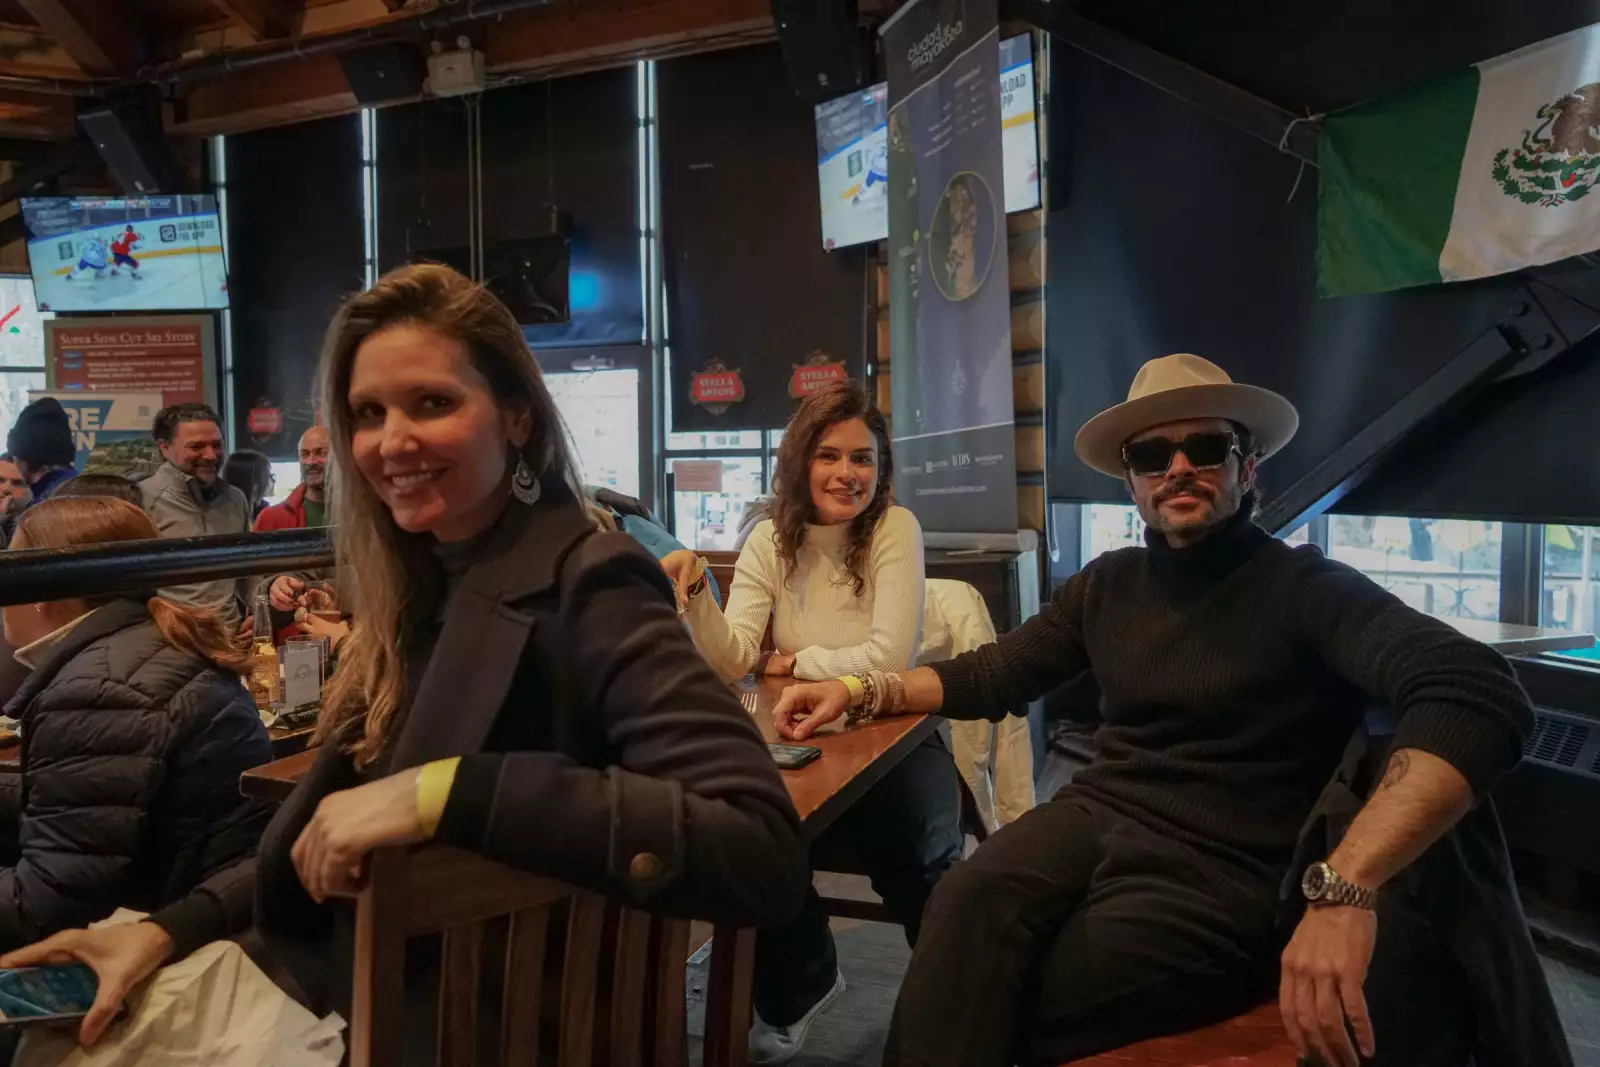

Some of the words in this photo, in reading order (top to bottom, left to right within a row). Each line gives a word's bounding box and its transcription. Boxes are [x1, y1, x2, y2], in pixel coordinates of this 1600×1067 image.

[799, 369, 838, 381] STELLA
[699, 377, 735, 388] STELLA
[801, 380, 829, 392] ART
[700, 387, 736, 398] ARTOIS
